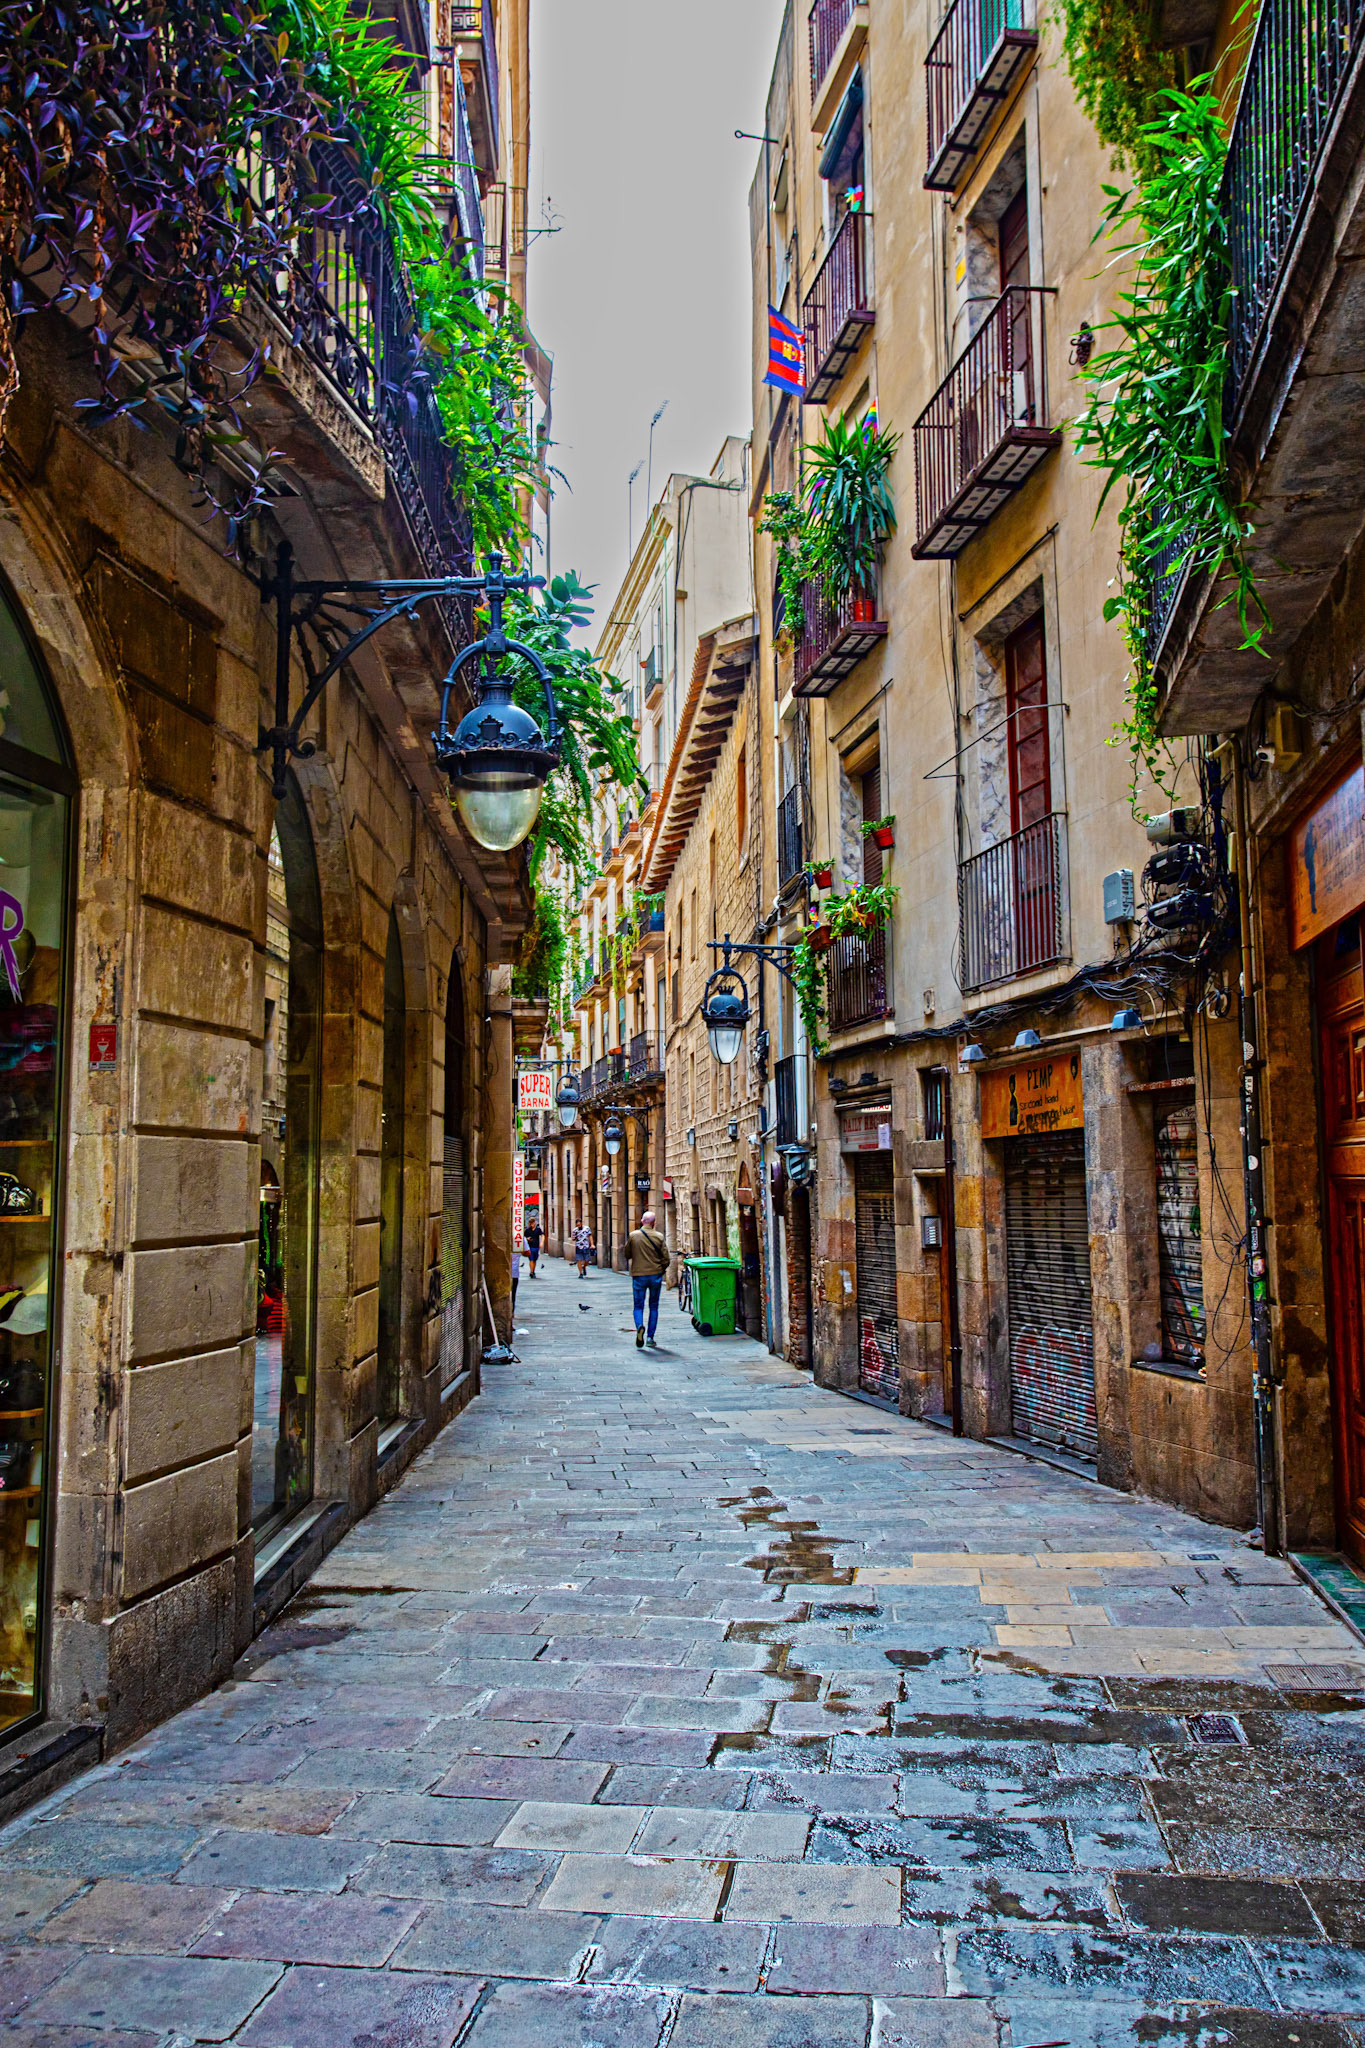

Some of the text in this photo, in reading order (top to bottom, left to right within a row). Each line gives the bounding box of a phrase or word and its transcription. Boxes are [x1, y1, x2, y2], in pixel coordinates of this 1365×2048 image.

[520, 1073, 551, 1097] SUPER
[1027, 1064, 1053, 1092] PIMP
[520, 1097, 550, 1108] BARNA
[842, 1116, 863, 1133] DAILY
[513, 1160, 523, 1248] SUPERMERCAT
